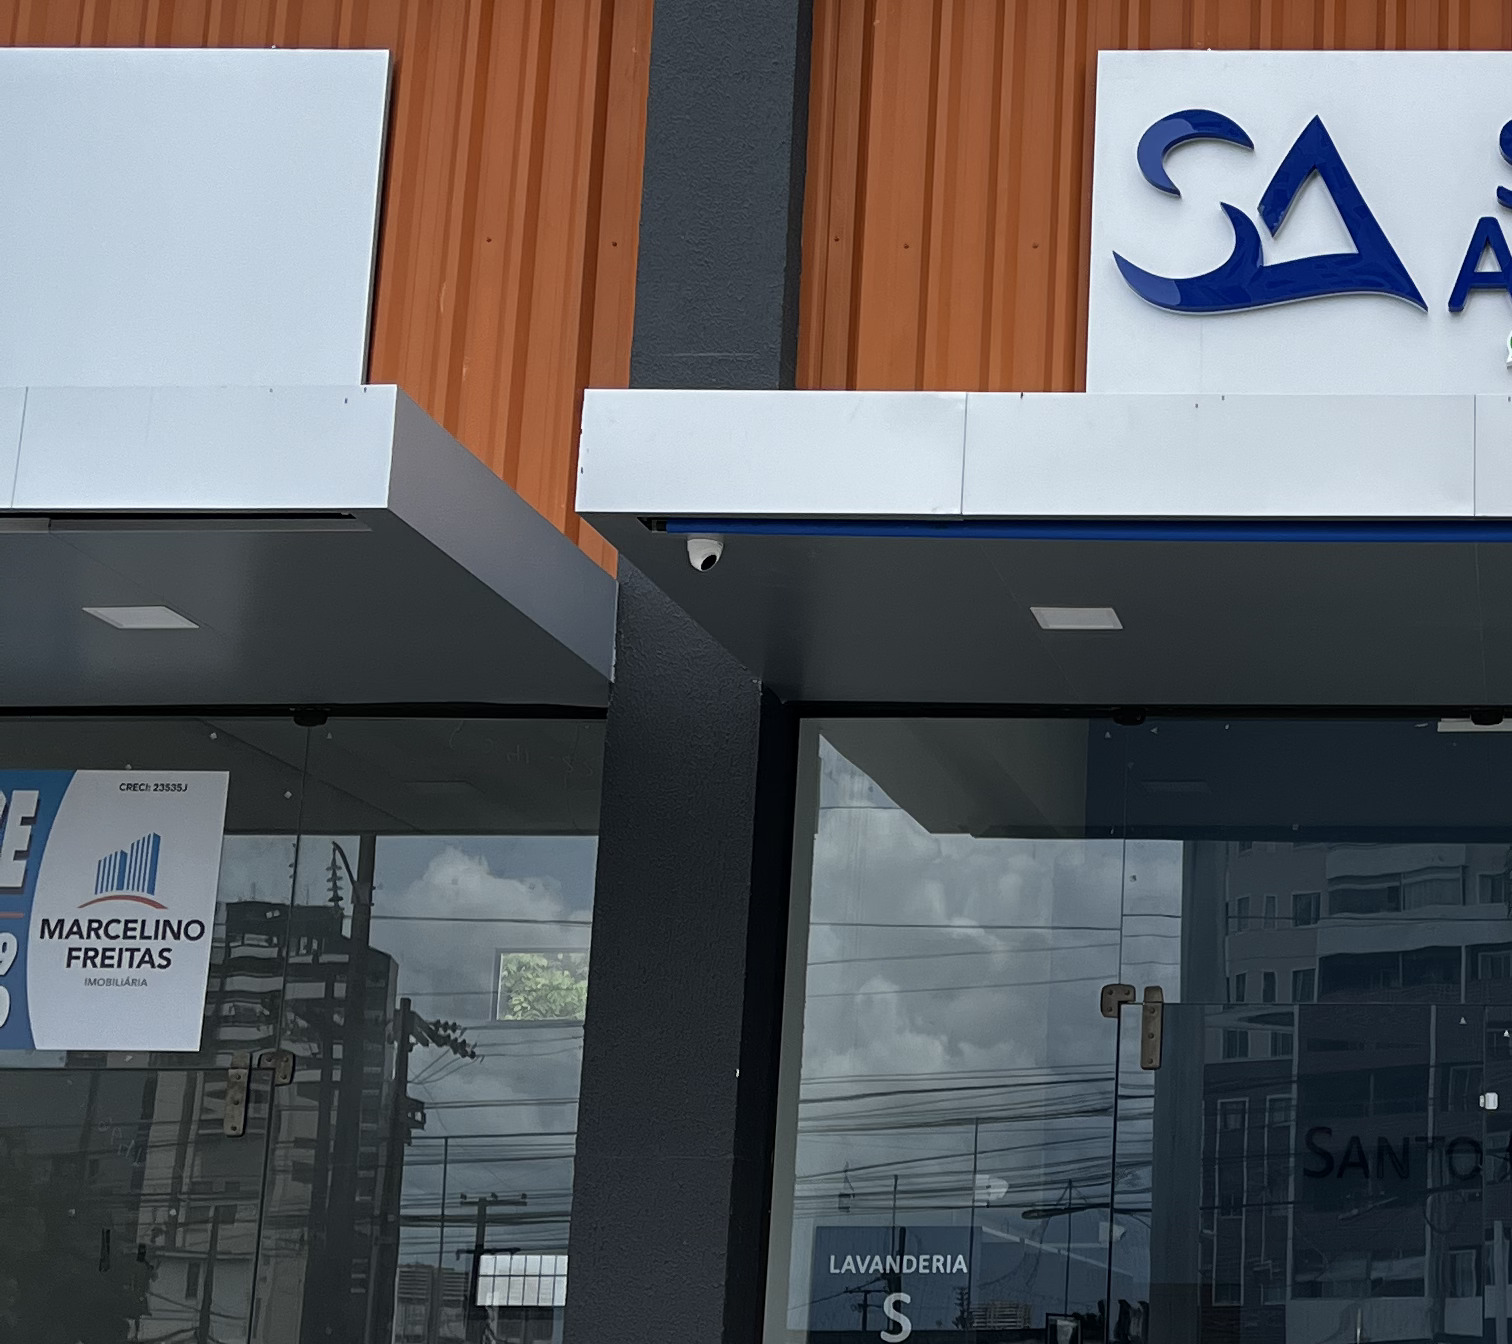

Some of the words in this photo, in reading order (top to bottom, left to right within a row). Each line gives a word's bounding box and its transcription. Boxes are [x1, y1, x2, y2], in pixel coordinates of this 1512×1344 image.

[39, 918, 206, 941] MARCELINO
[66, 946, 173, 970] FREITAS
[84, 975, 149, 987] IMOBILIÁRIA
[1303, 1126, 1482, 1181] SANTO
[828, 1254, 969, 1275] LAVANDERIA
